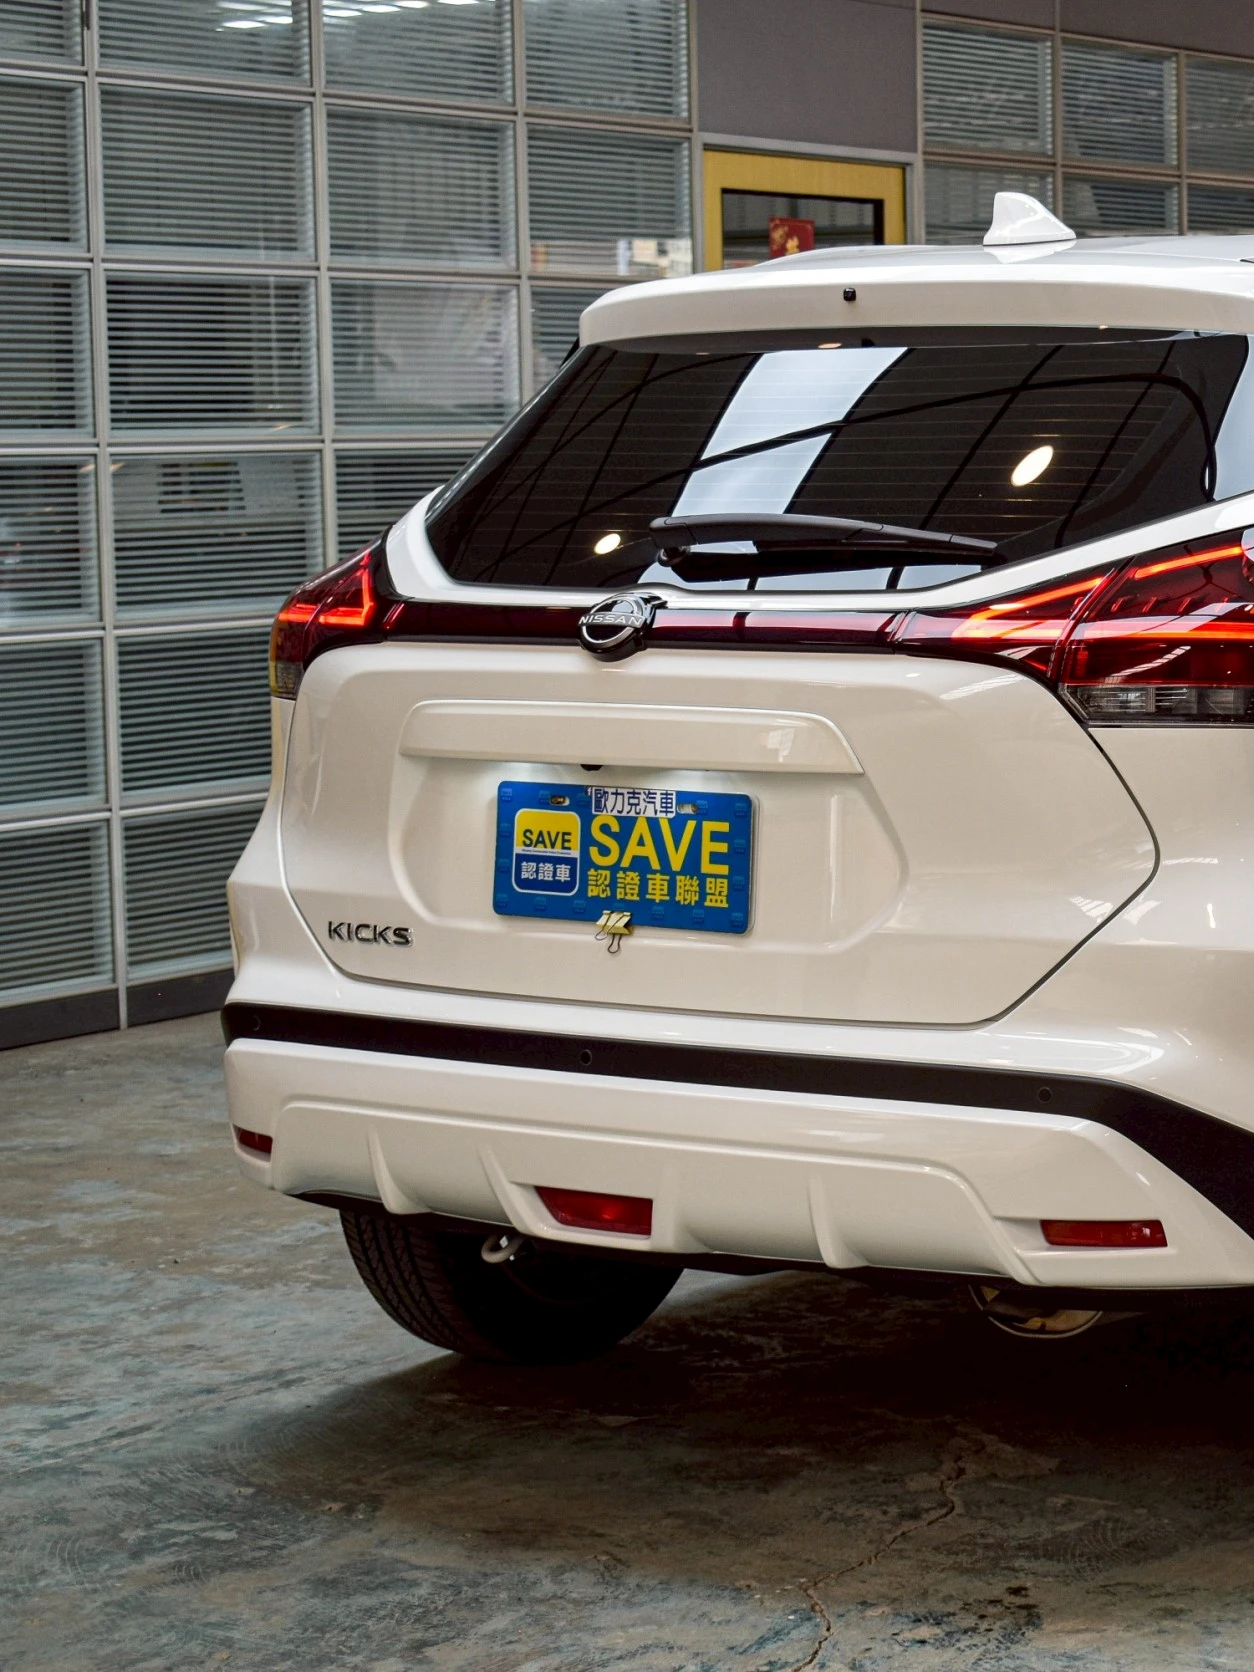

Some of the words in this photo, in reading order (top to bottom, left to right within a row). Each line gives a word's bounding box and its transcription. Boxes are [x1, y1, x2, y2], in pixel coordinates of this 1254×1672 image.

[578, 614, 643, 626] NISSAN
[594, 788, 675, 816] 歐力克汽車
[522, 828, 572, 850] SAVE
[589, 815, 730, 875] SAVE
[521, 861, 571, 882] 認證車
[587, 868, 729, 908] 認證車聯盟
[328, 921, 413, 946] KICKS
